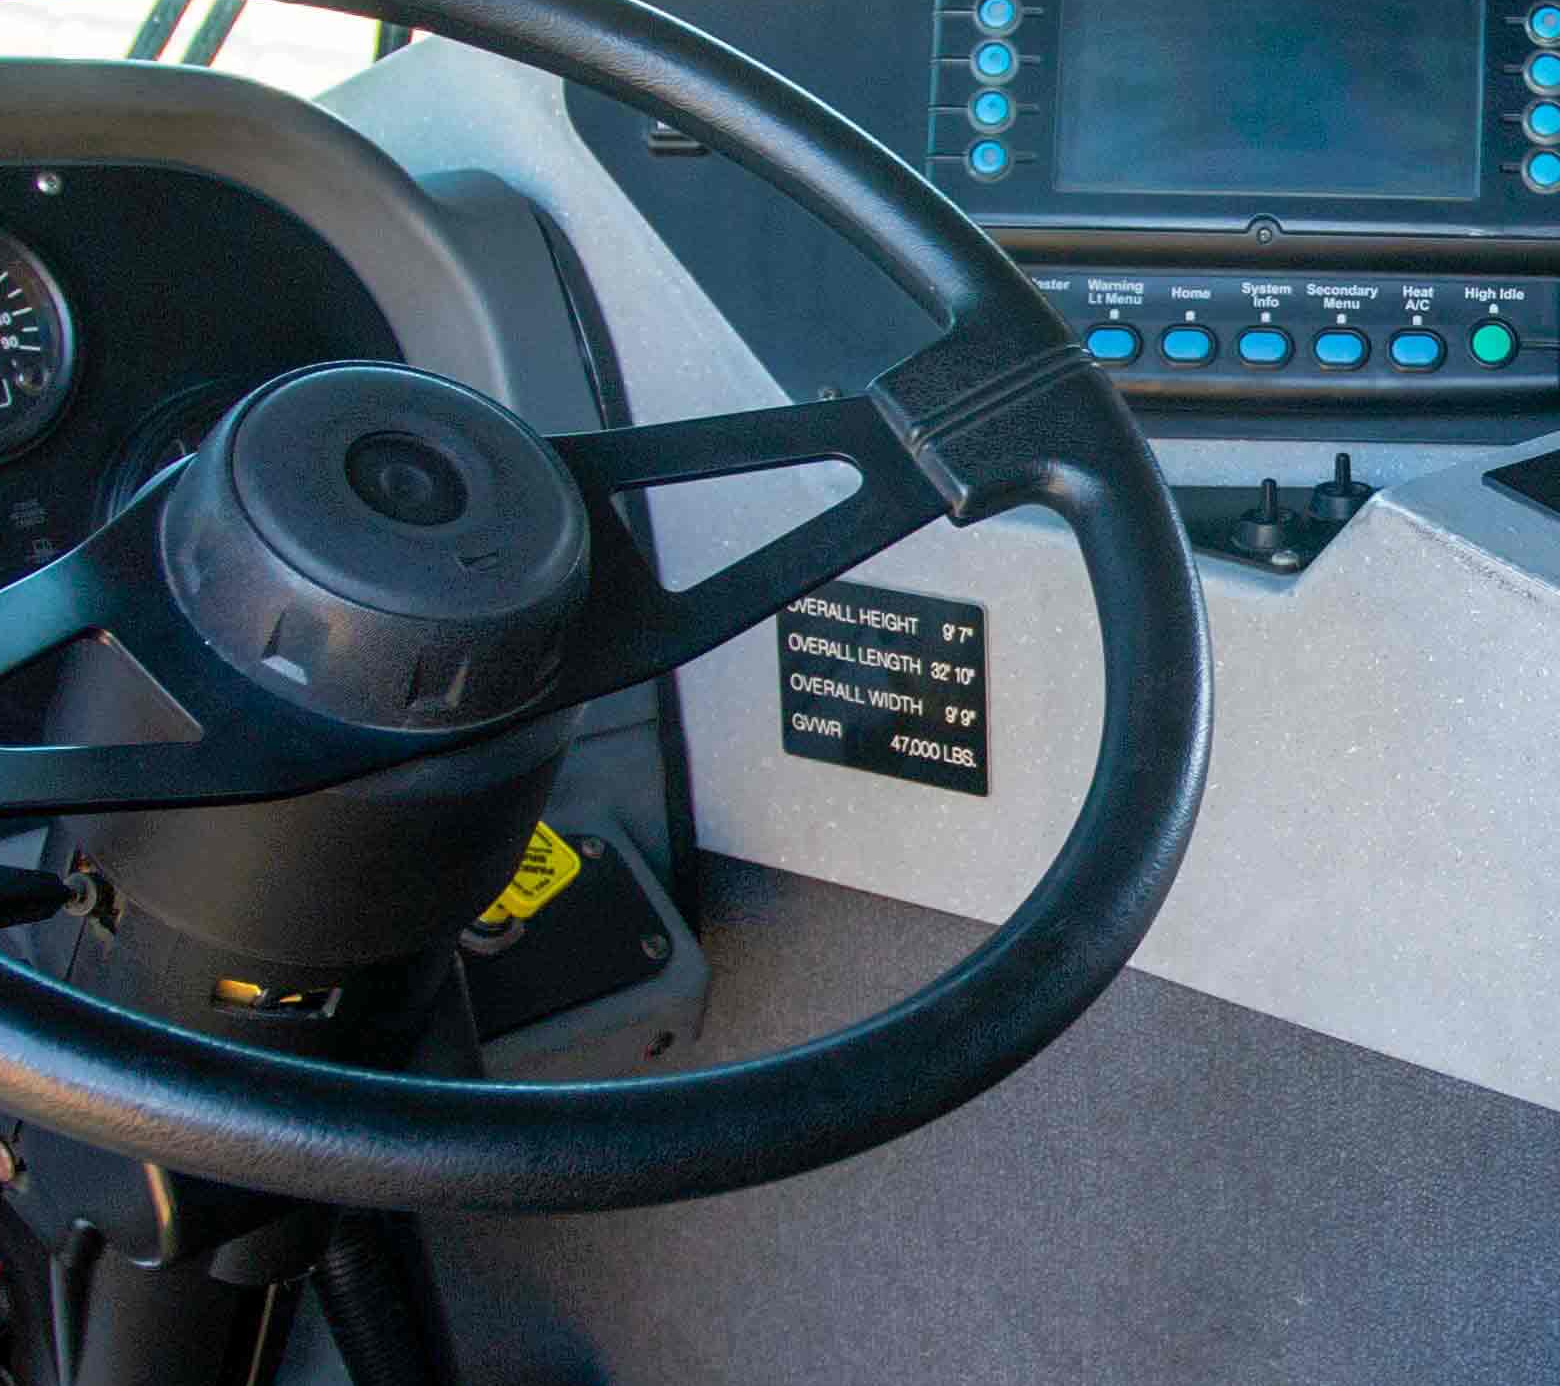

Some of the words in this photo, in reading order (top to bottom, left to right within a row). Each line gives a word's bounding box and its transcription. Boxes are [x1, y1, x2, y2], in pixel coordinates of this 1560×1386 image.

[1088, 278, 1144, 294] Warning
[1172, 286, 1211, 299] Home
[1242, 282, 1291, 297] System
[1306, 284, 1378, 299] Secondary
[1403, 286, 1434, 298] Heat
[1088, 294, 1104, 305] Lt
[1105, 294, 1143, 305] Menu
[1253, 296, 1279, 308] Info
[1465, 287, 1496, 302] High
[1499, 287, 1525, 301] Idle
[1324, 297, 1360, 310] Menu
[1405, 299, 1430, 311] A/C
[0, 336, 18, 349] 90
[859, 608, 919, 635] HEIGHT
[788, 633, 856, 662] OVERALL
[858, 646, 921, 675] LENGTH
[790, 673, 864, 705] OVERALL
[868, 690, 923, 716] WIDTH
[792, 713, 843, 738] GVWR
[890, 734, 940, 760] 47,000
[943, 745, 977, 768] LBS.
